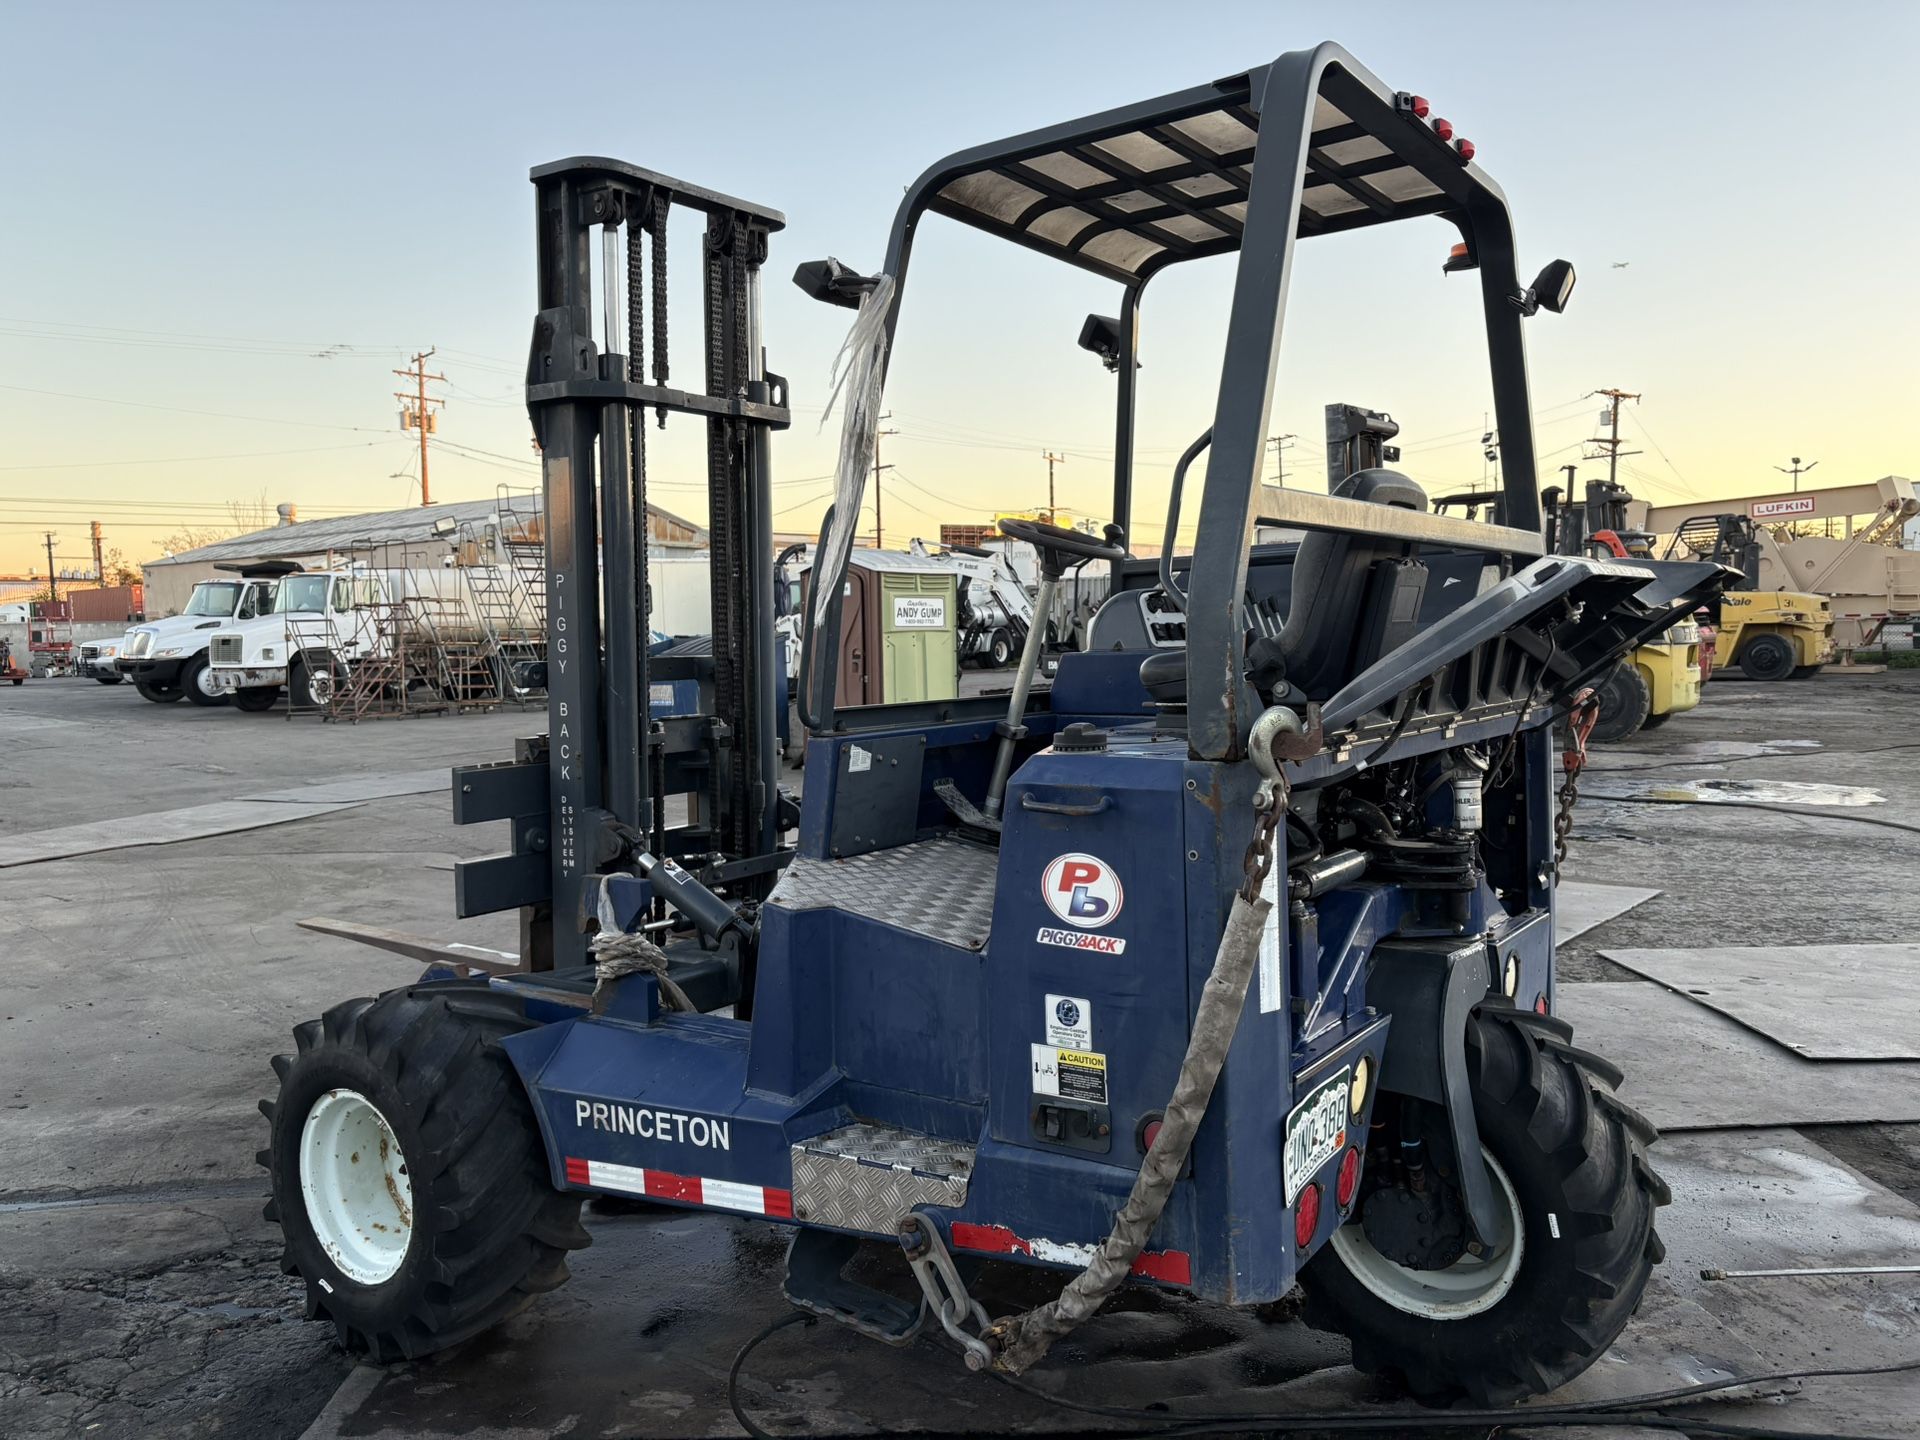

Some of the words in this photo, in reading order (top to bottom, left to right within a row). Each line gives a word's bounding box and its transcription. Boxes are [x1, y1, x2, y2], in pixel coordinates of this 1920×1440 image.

[1757, 501, 1809, 514] LUFKIN
[556, 574, 567, 674] PIGGY
[896, 607, 919, 618] ANDY
[920, 607, 943, 618] GUMP
[559, 702, 570, 780] BACK
[1067, 1054, 1104, 1066] CAUTION
[575, 1099, 730, 1151] PRINCETON
[1299, 1143, 1330, 1181] COLORADO
